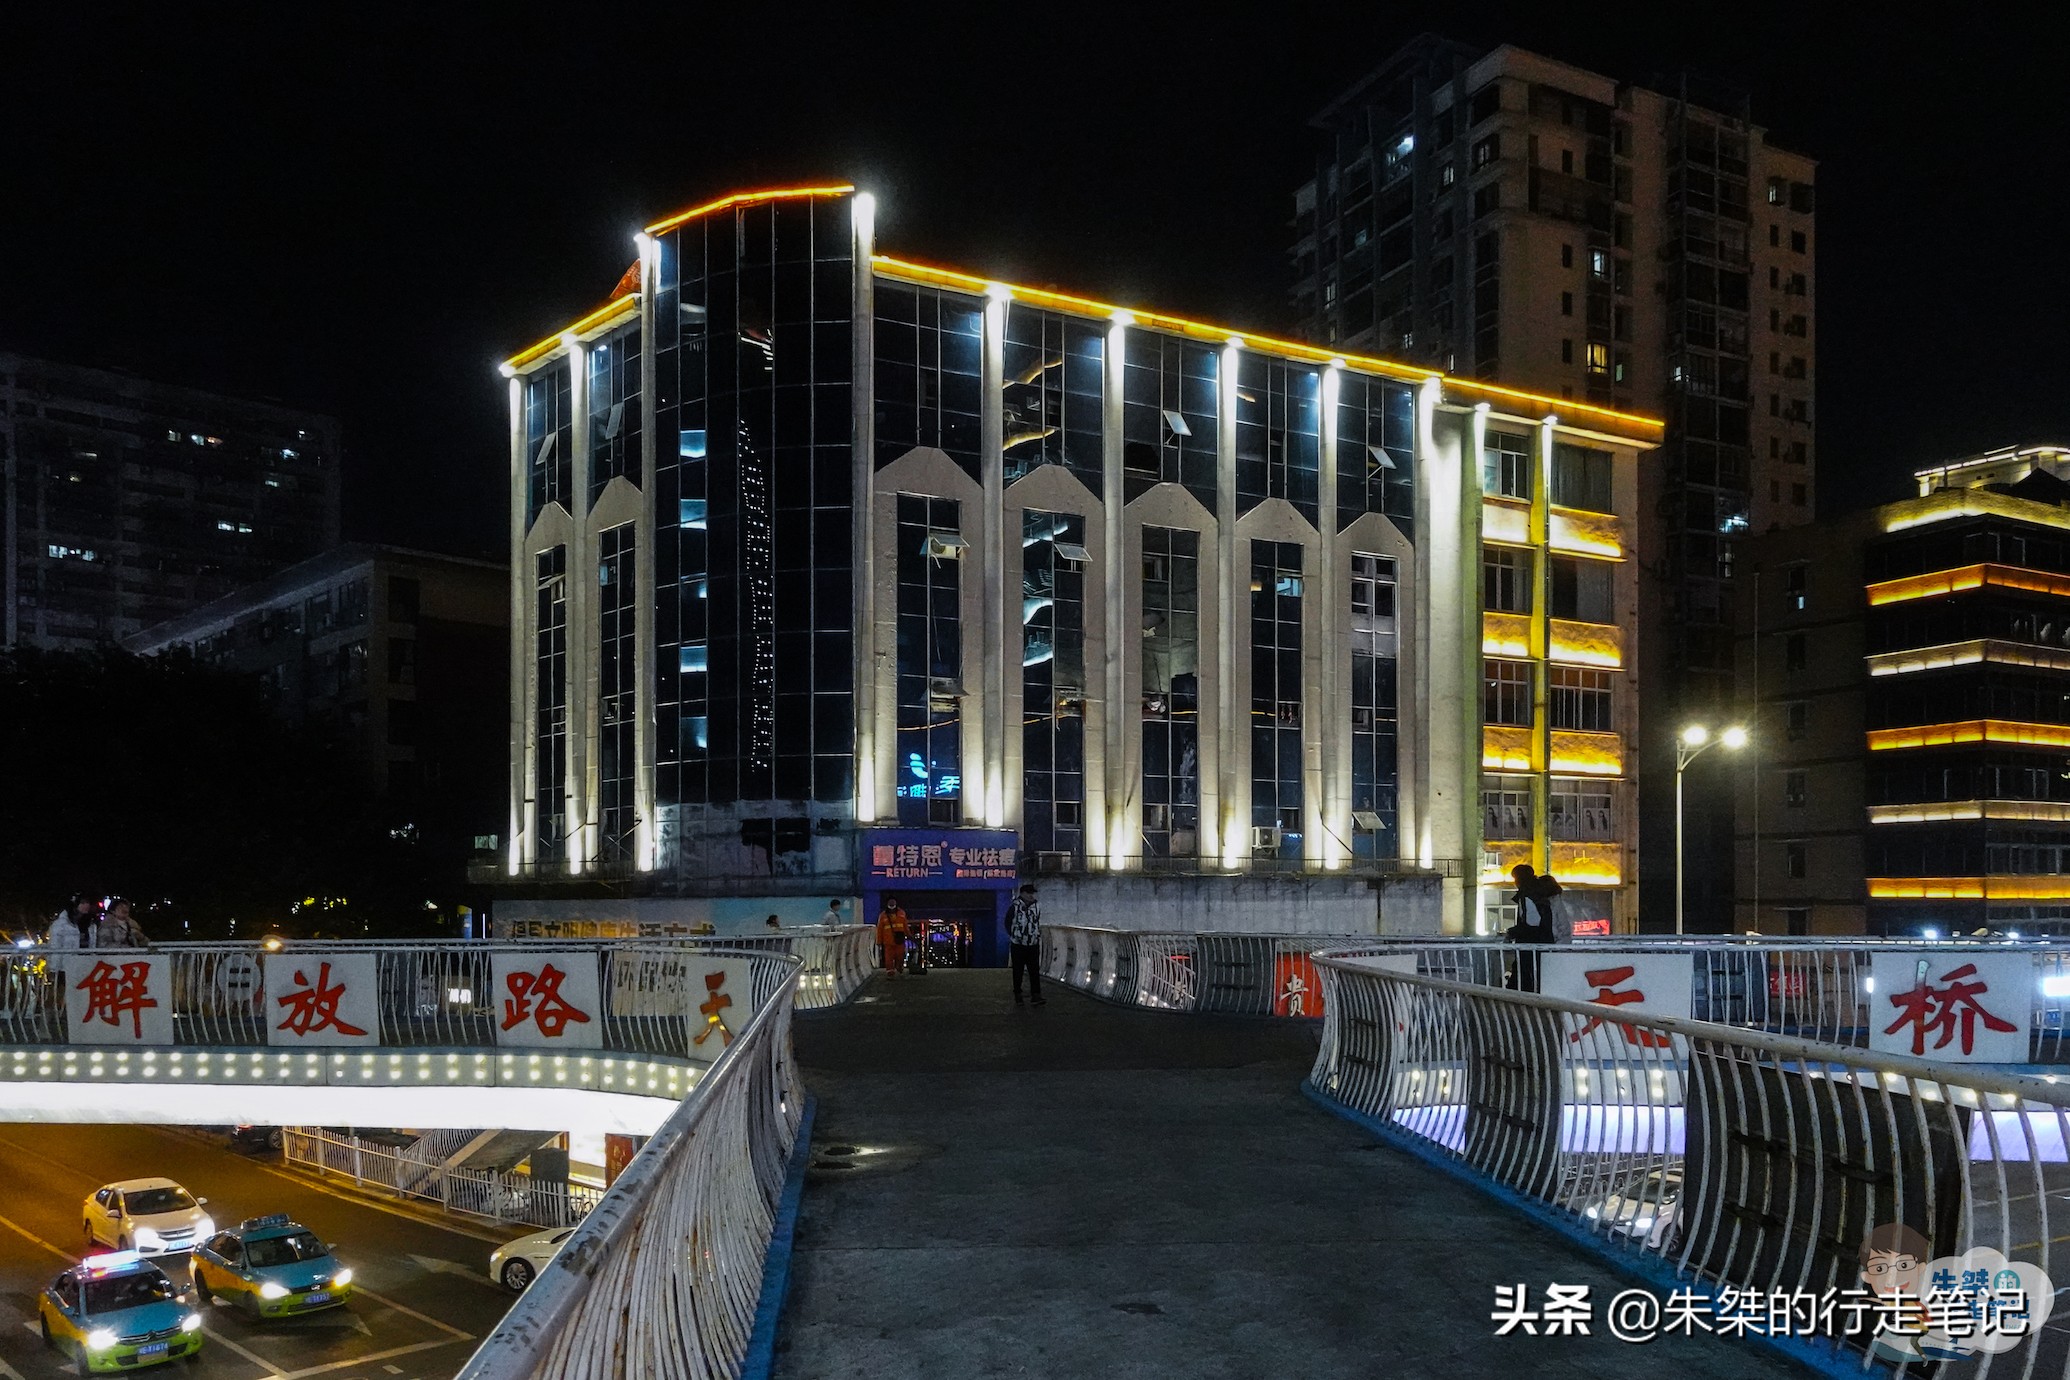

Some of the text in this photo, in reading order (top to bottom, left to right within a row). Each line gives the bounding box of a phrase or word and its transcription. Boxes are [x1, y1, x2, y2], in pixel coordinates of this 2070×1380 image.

[76, 961, 158, 1038] 解
[277, 961, 368, 1036] 放
[501, 963, 590, 1037] 路
[1570, 959, 2018, 1055] 天 桥
